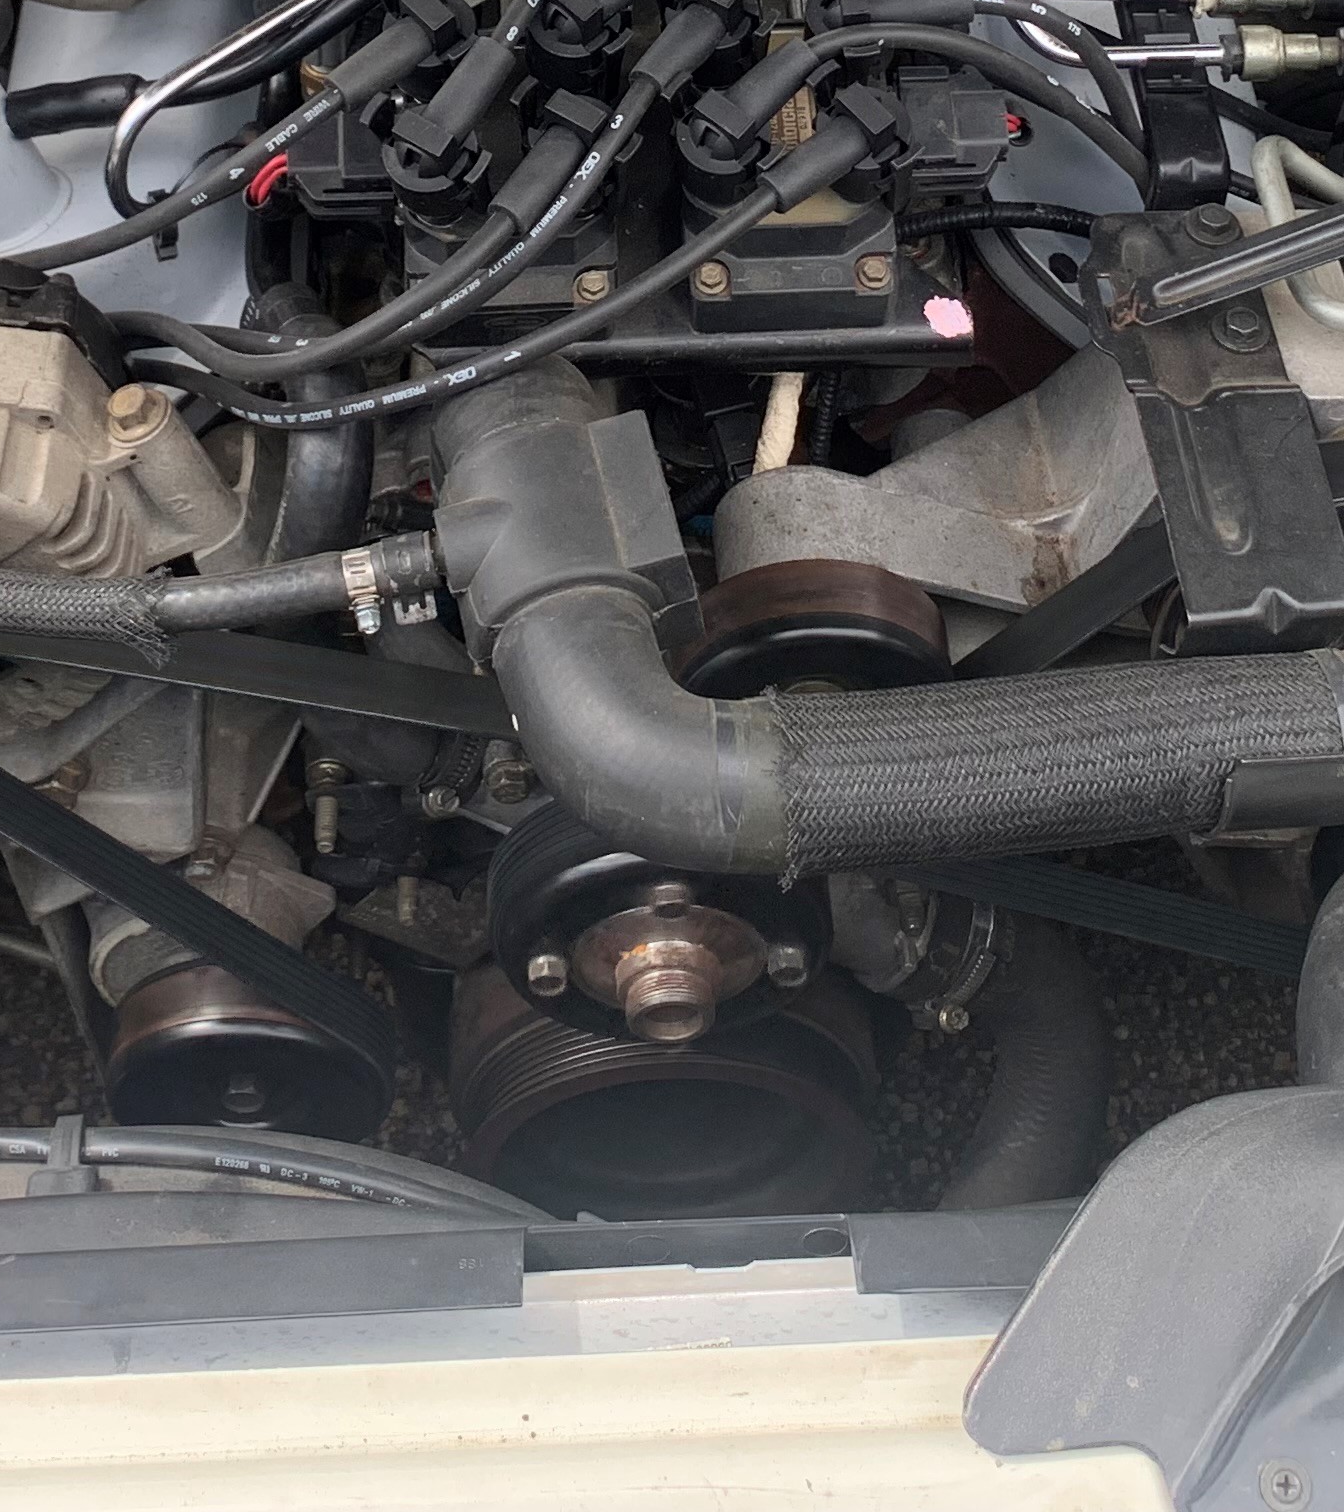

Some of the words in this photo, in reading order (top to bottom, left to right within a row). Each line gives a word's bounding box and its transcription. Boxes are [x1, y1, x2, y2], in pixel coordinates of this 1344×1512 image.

[1031, 2, 1047, 16] 5
[1067, 21, 1081, 36] 175
[506, 25, 519, 41] 8
[303, 99, 331, 122] WIRE
[610, 114, 624, 129] 3
[265, 123, 298, 152] CABLE
[229, 167, 245, 180] 4
[191, 192, 208, 206] 175
[529, 195, 568, 238] PREMIUM
[487, 241, 525, 277] QUALITY
[440, 278, 481, 310] SILICONE
[382, 383, 426, 405] PREMIUM
[338, 399, 375, 416] QUALITY
